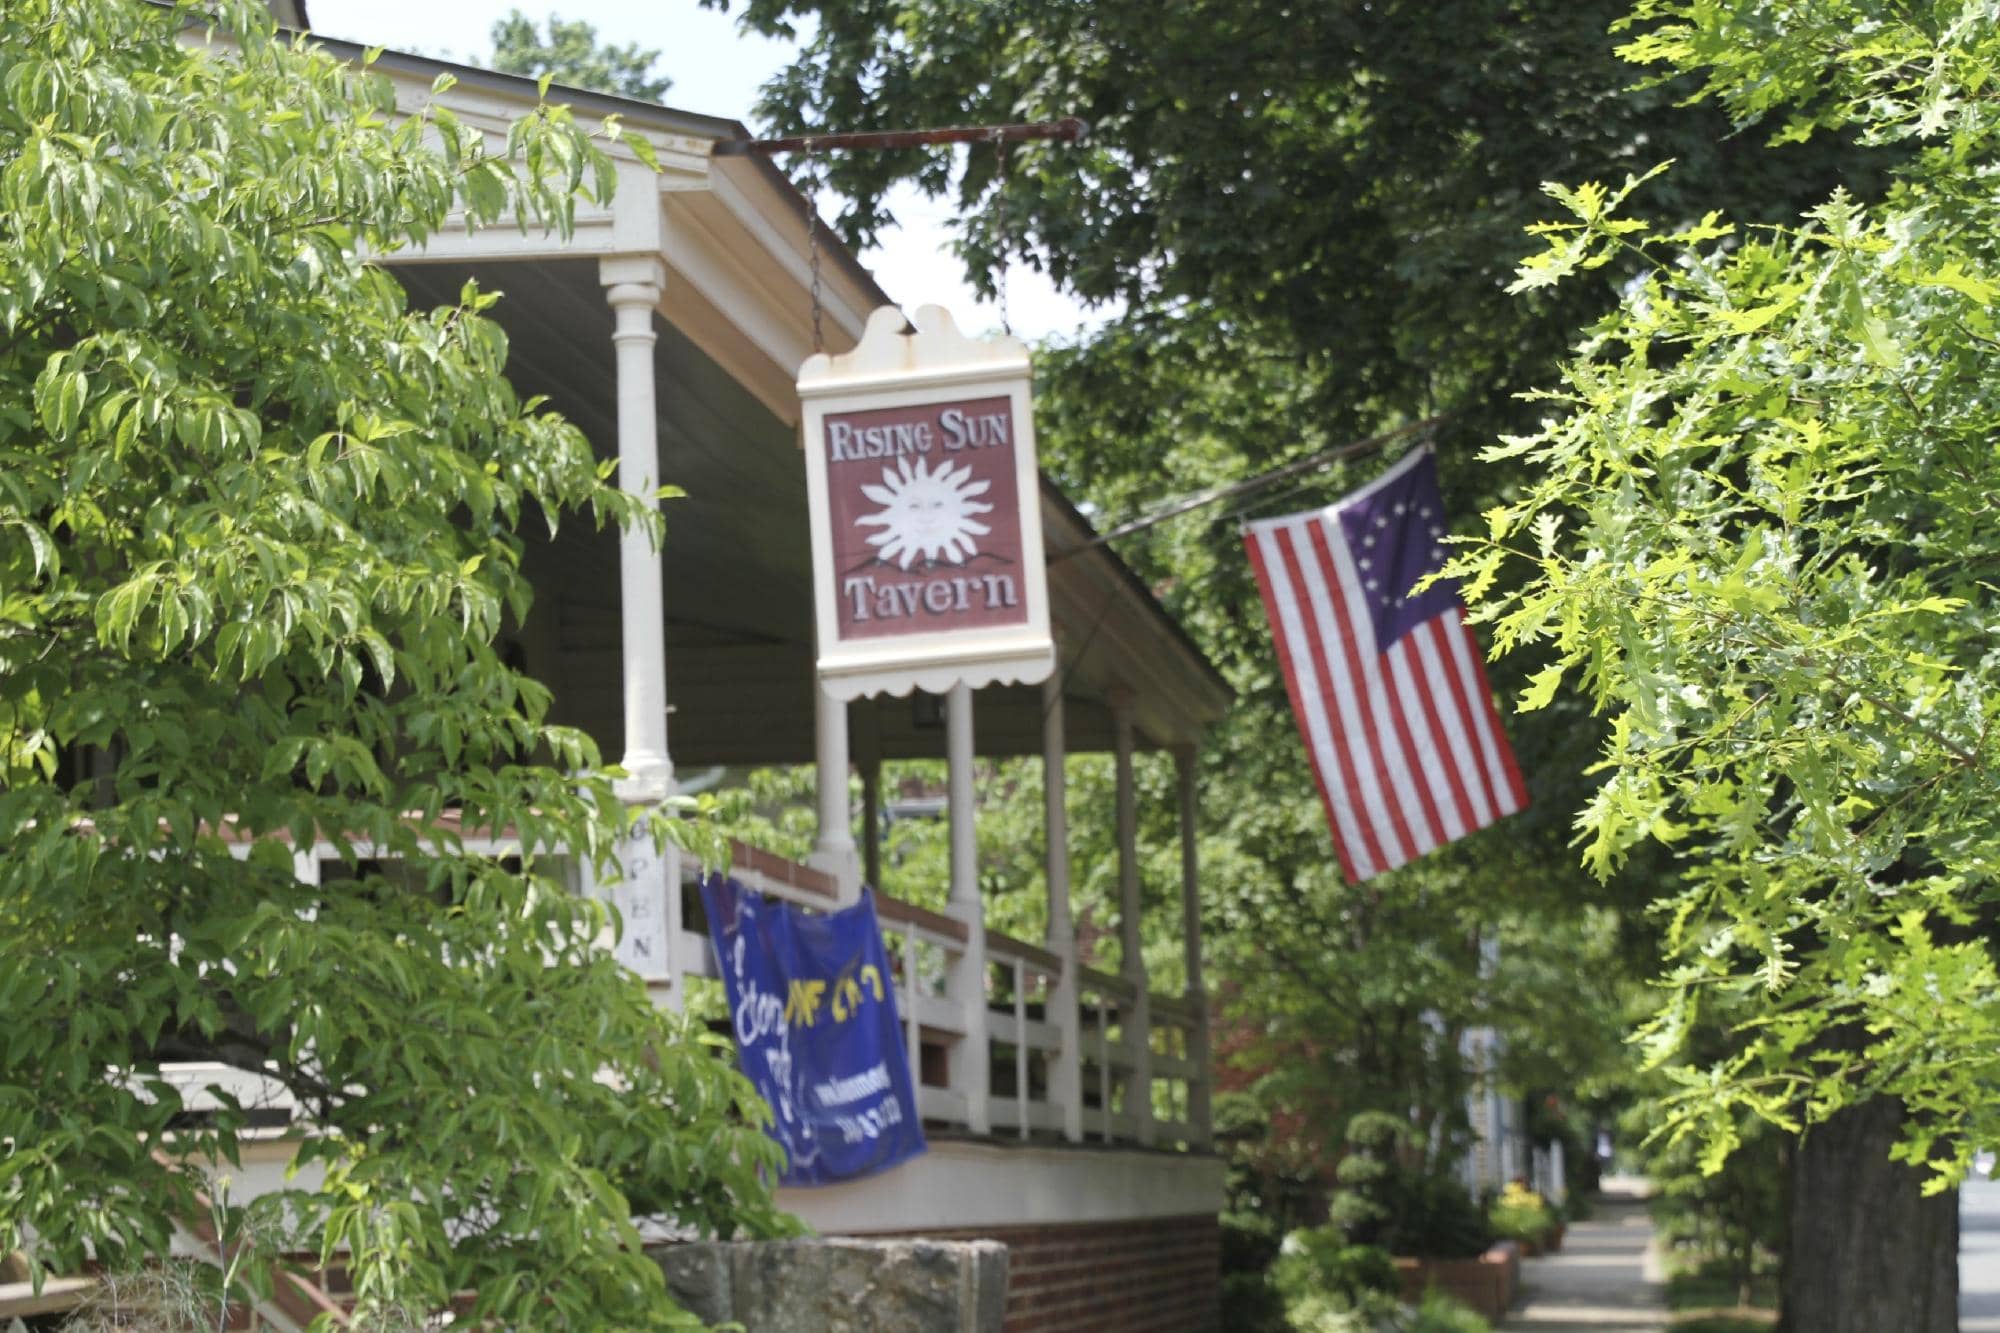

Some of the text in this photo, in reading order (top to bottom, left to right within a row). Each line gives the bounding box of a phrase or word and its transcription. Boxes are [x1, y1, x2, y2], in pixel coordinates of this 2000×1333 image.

[829, 408, 1009, 462] RISING SUN
[844, 573, 1017, 622] Tavern
